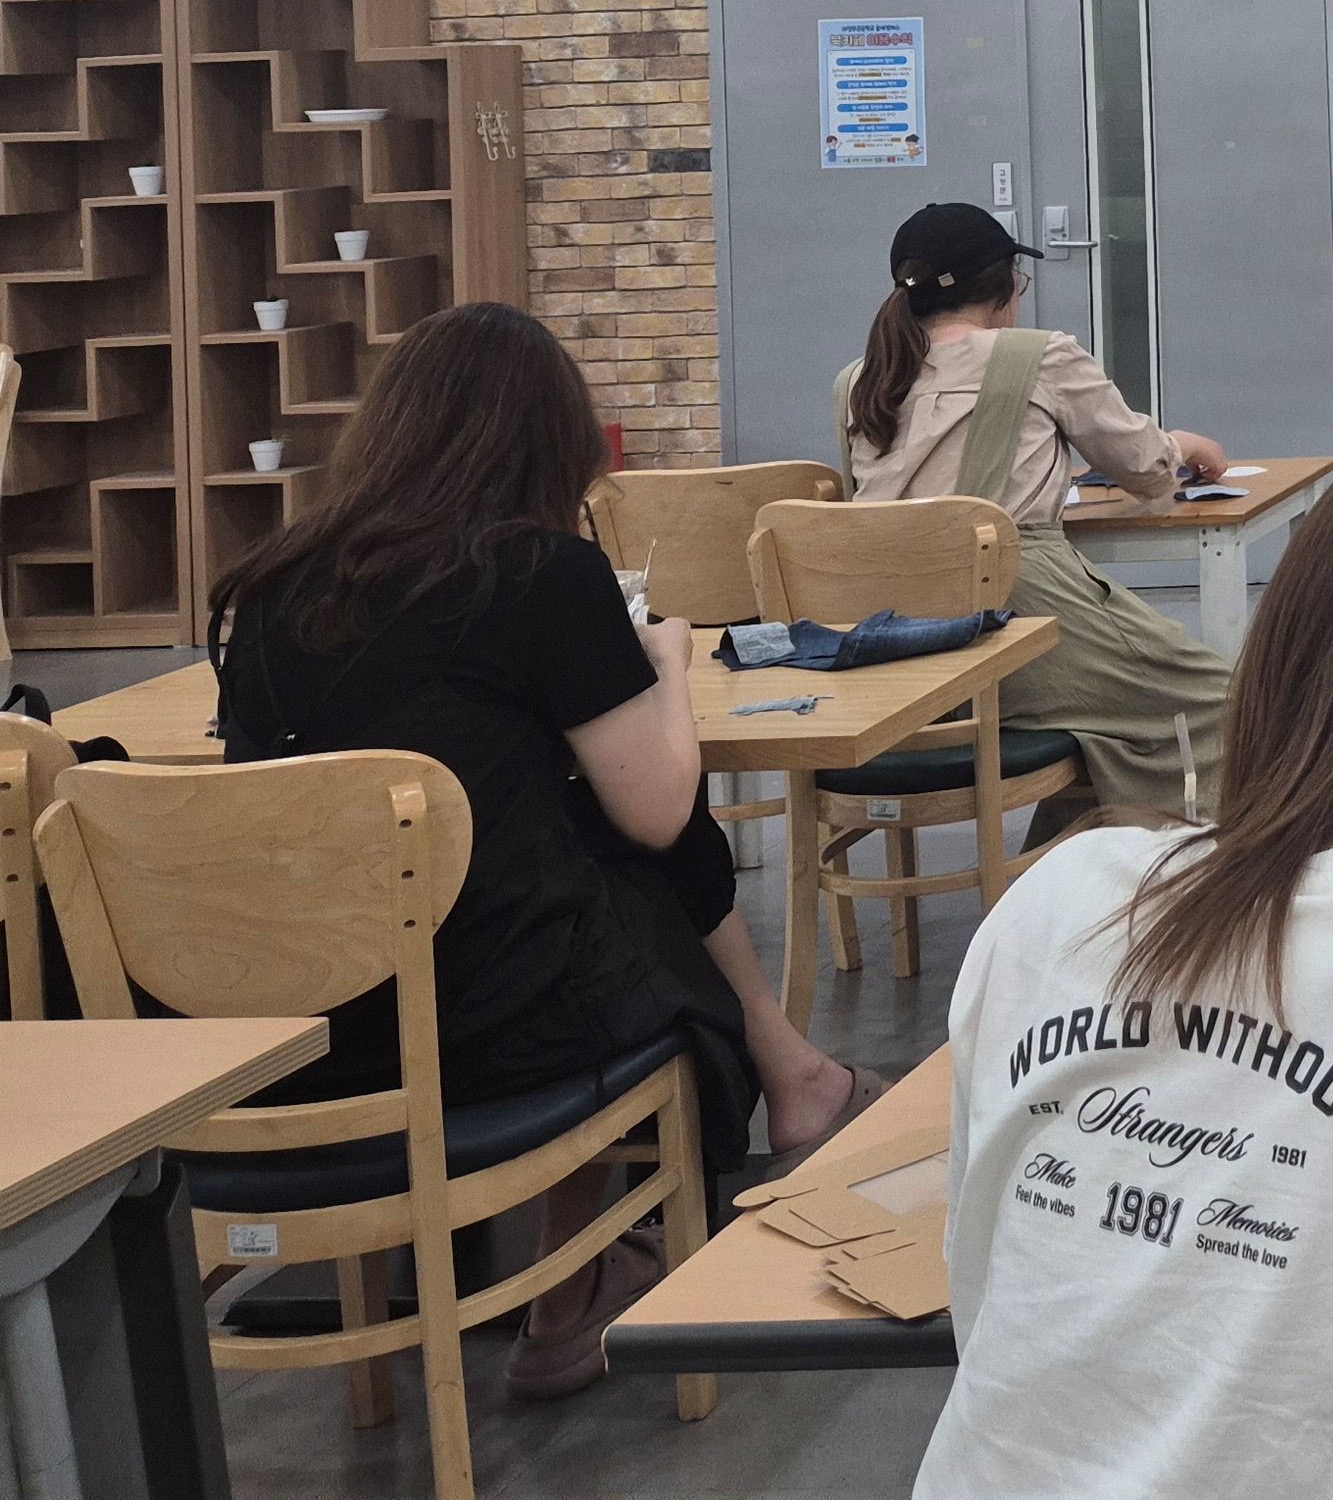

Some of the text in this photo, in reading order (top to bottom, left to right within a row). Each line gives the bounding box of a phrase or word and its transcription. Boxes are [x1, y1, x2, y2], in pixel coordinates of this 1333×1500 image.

[1009, 1000, 1152, 1090] WORLD
[1029, 1086, 1308, 1169] EST. Strangers 1981
[1015, 1184, 1075, 1217] Feel the vibes
[1024, 1153, 1299, 1248] Make 1981 Memories
[1196, 1233, 1288, 1269] Spread the love
